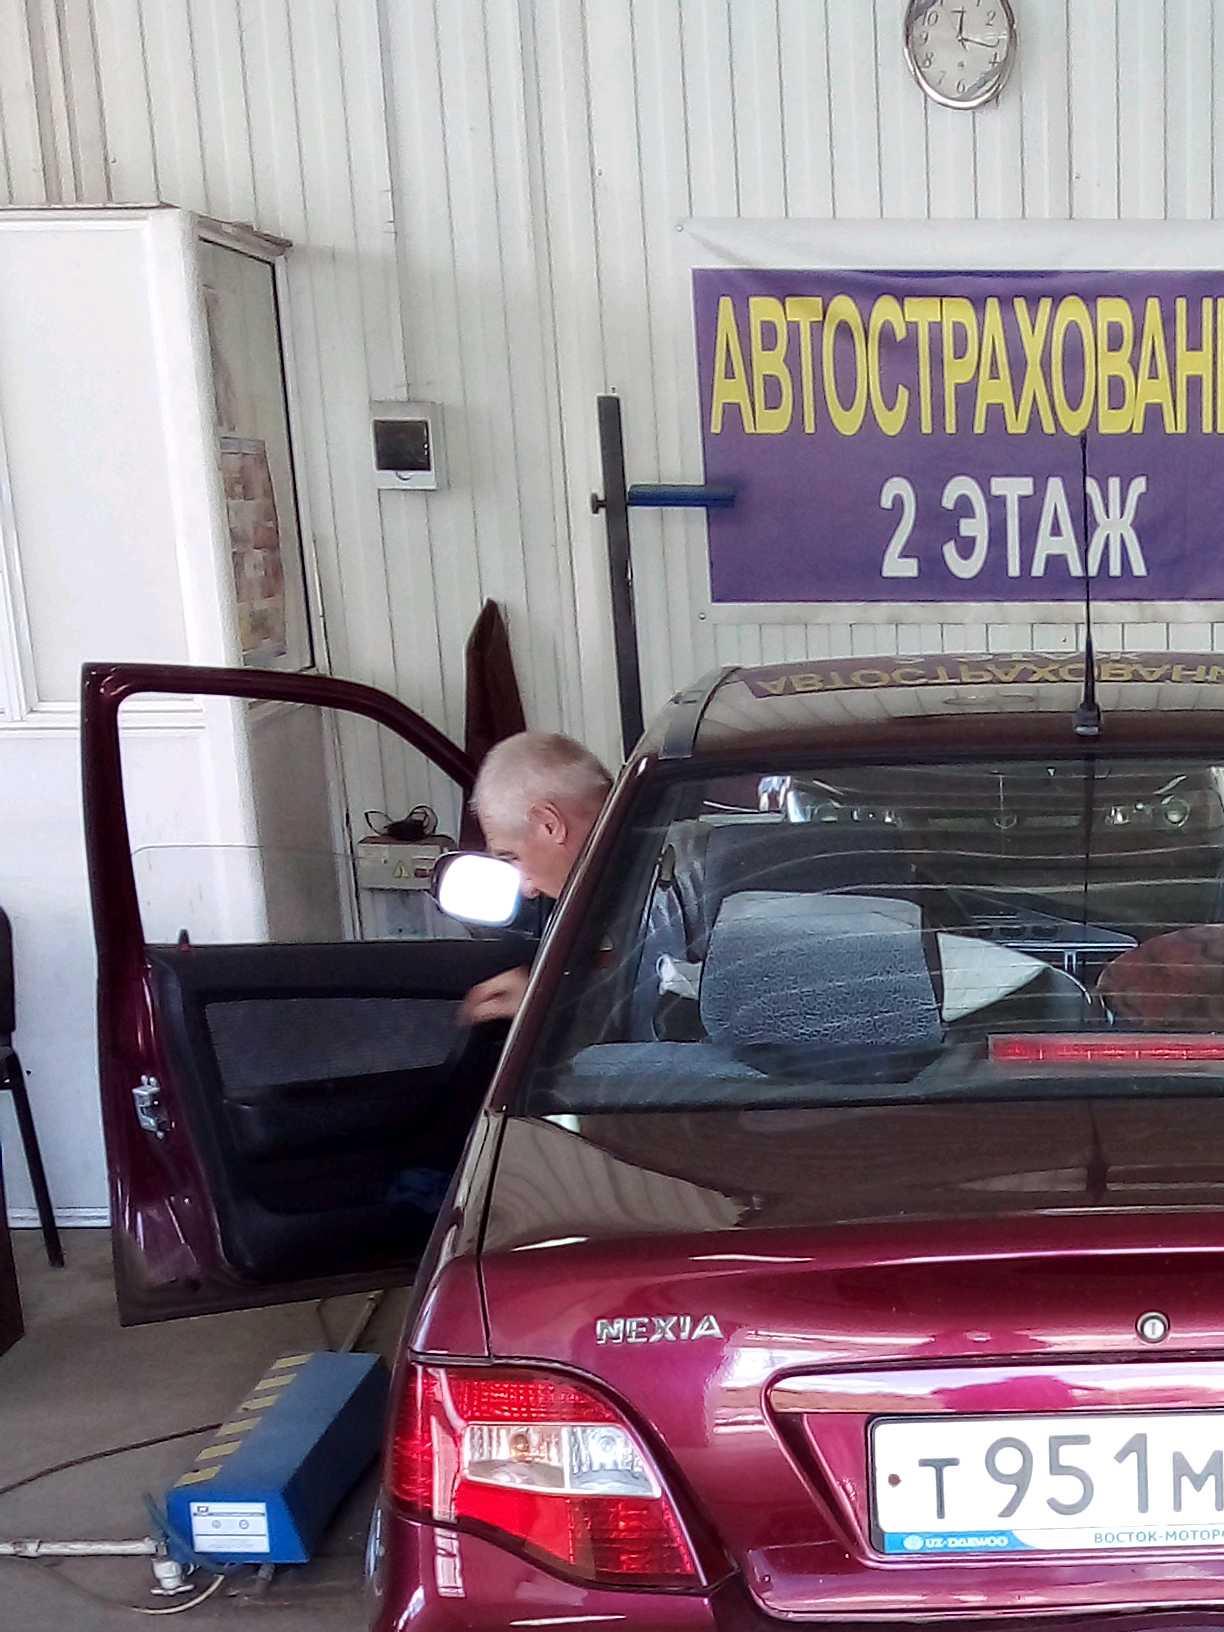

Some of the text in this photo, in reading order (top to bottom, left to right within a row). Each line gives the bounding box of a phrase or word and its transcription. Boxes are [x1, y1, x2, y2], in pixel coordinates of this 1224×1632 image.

[880, 475, 1148, 578] 2 ЭТАЖ
[595, 1314, 724, 1345] NEXIA
